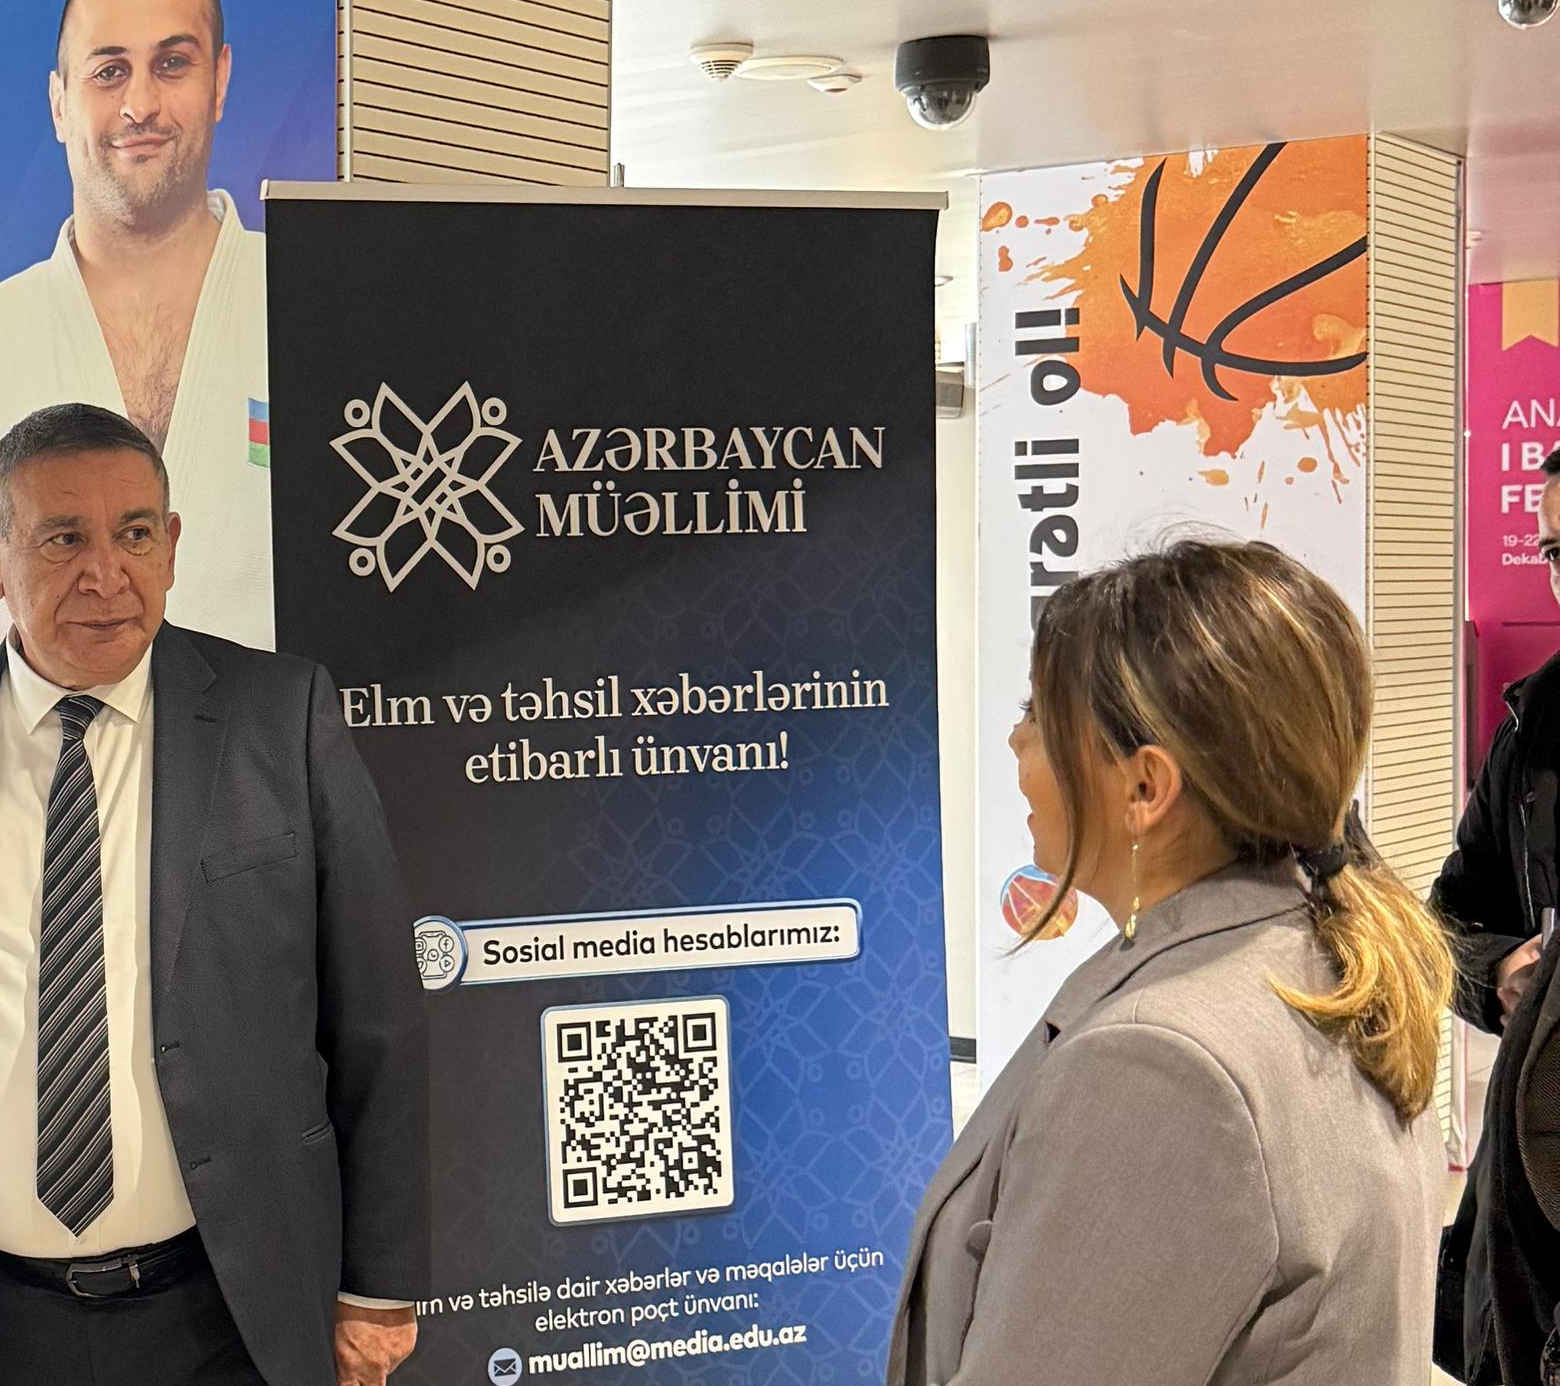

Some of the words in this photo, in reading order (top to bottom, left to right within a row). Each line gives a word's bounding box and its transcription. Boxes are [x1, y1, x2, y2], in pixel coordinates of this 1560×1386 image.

[1502, 398, 1560, 429] AN
[533, 426, 886, 472] AZƏRBAYCAN
[535, 478, 808, 538] MÜƏLLİMİ
[339, 683, 435, 728] Elm
[442, 692, 492, 724] və
[500, 674, 623, 722] təhsil
[630, 669, 890, 716] xəbərlərinin
[465, 735, 623, 783] etibarlı
[632, 730, 790, 776] ünvanı!
[483, 934, 565, 966] Sosial
[572, 929, 656, 960] media
[663, 921, 841, 953] hesablarımız:
[448, 1294, 474, 1312] və
[479, 1280, 551, 1309] təhsilə
[557, 1276, 600, 1300] dair
[605, 1266, 690, 1295] xəbərlər
[695, 1270, 720, 1285] və
[726, 1252, 829, 1282] məqalələr
[834, 1247, 884, 1273] üçün
[535, 1307, 625, 1332] elektron
[631, 1298, 679, 1327] poçt
[684, 1292, 759, 1316] ünvanı:
[529, 1324, 807, 1374] muallim@media.edu.az
